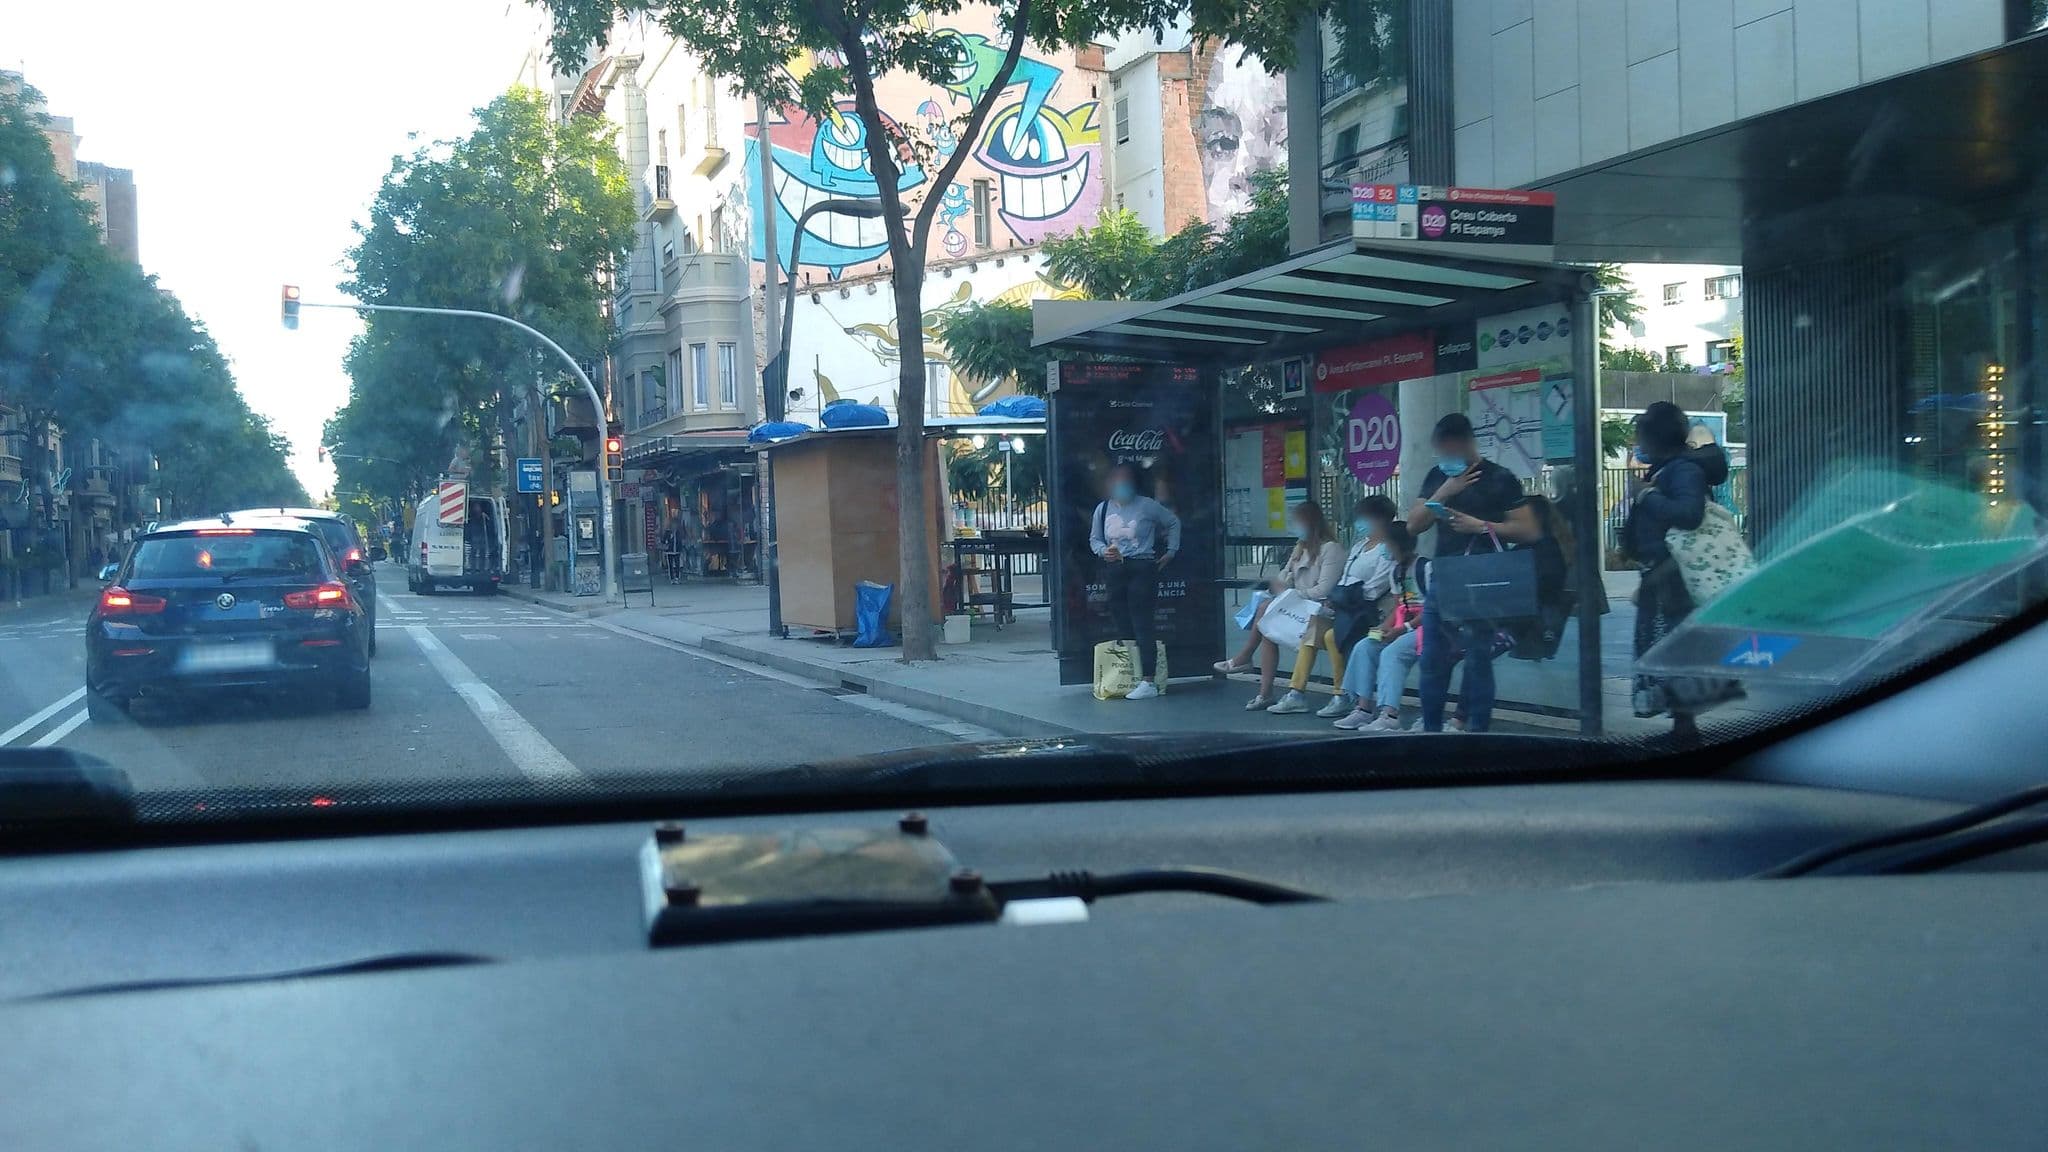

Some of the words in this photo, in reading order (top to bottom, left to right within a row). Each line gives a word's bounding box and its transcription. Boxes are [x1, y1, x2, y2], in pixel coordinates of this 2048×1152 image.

[1352, 187, 1375, 199] D20
[1422, 214, 1446, 227] D20
[1450, 209, 1475, 221] Creu
[1477, 210, 1517, 223] Coberta
[1450, 223, 1462, 234] Pl
[1463, 224, 1506, 237] Espanya
[1394, 351, 1425, 365] Espanya
[1349, 414, 1399, 453] D20
[1085, 583, 1106, 591] SOM
[1167, 581, 1186, 589] UNA
